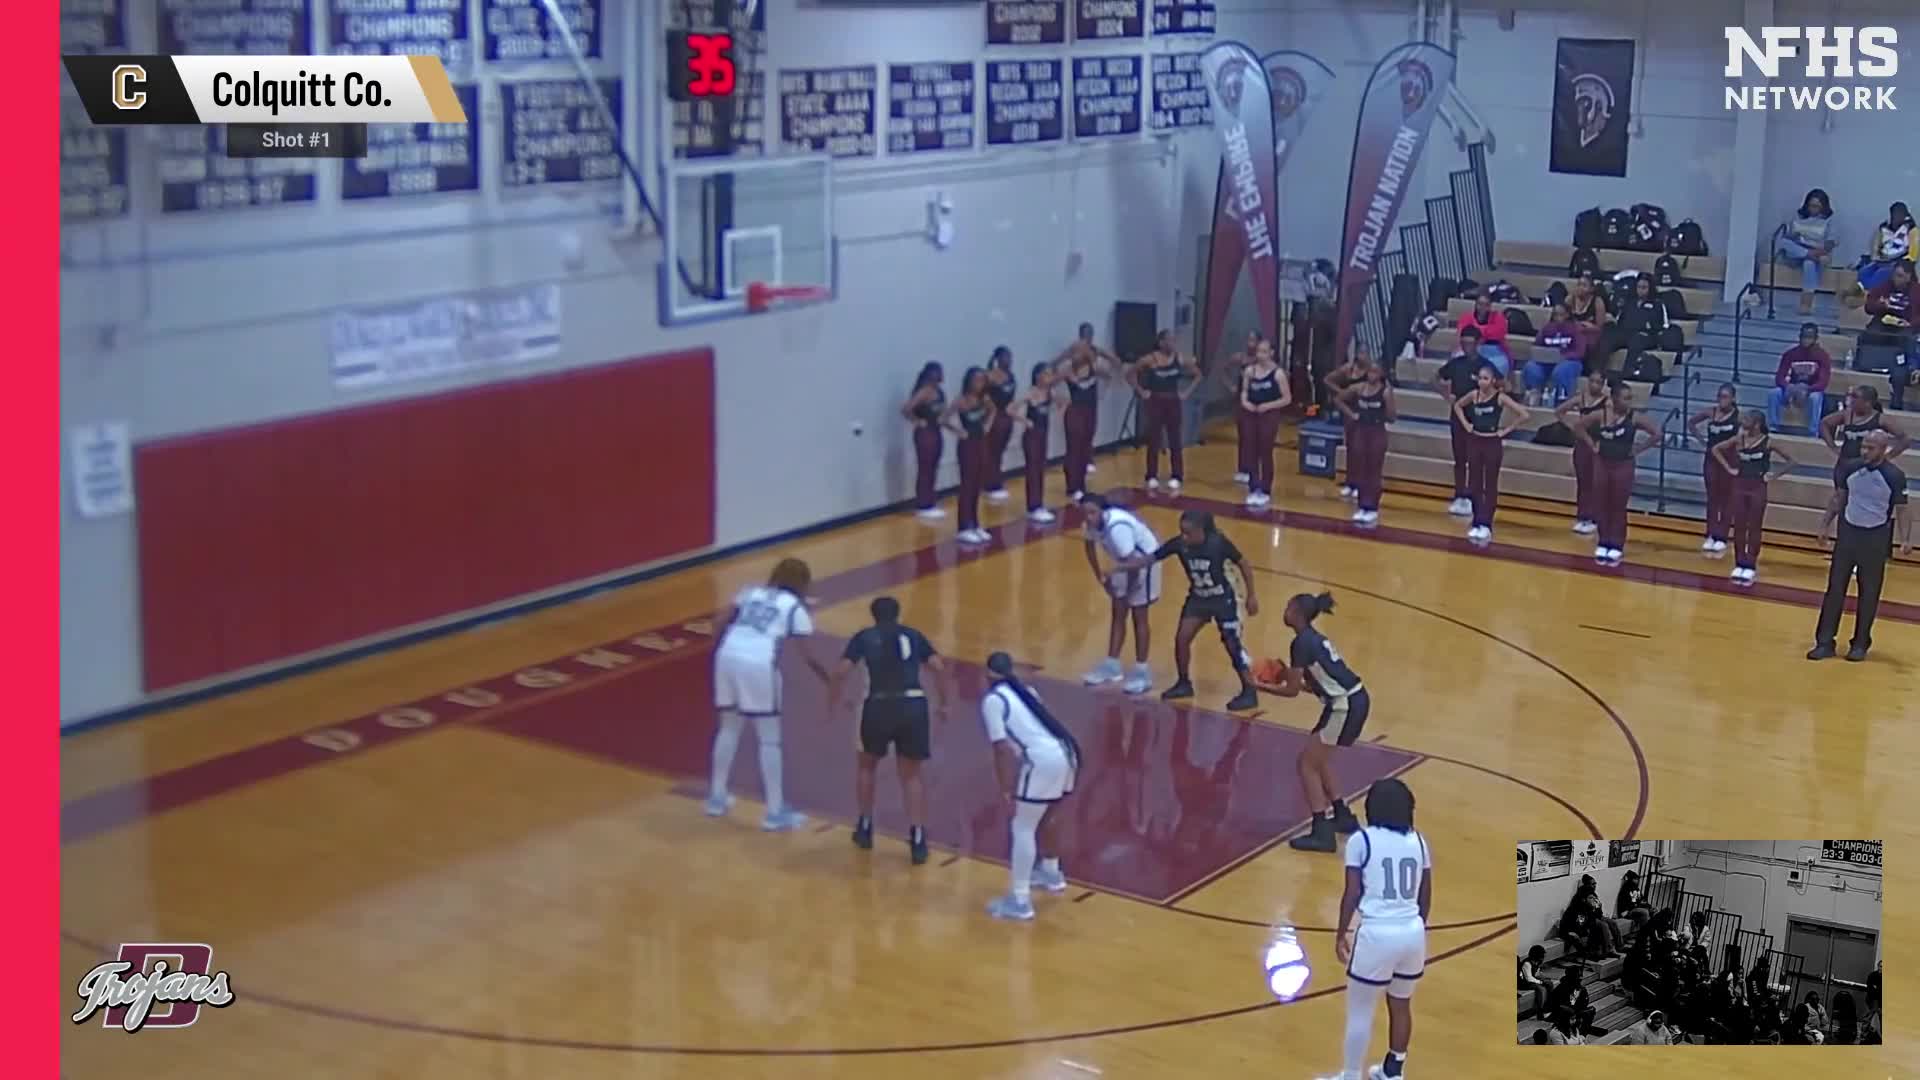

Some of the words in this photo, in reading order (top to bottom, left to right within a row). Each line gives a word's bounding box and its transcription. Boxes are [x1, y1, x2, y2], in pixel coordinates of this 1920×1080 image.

[345, 14, 454, 41] CHAMPIONS
[1350, 193, 1392, 271] TROJAN
[1378, 125, 1419, 197] NATION
[1832, 840, 1882, 855] CHAMPIONS
[1381, 857, 1418, 900] 10
